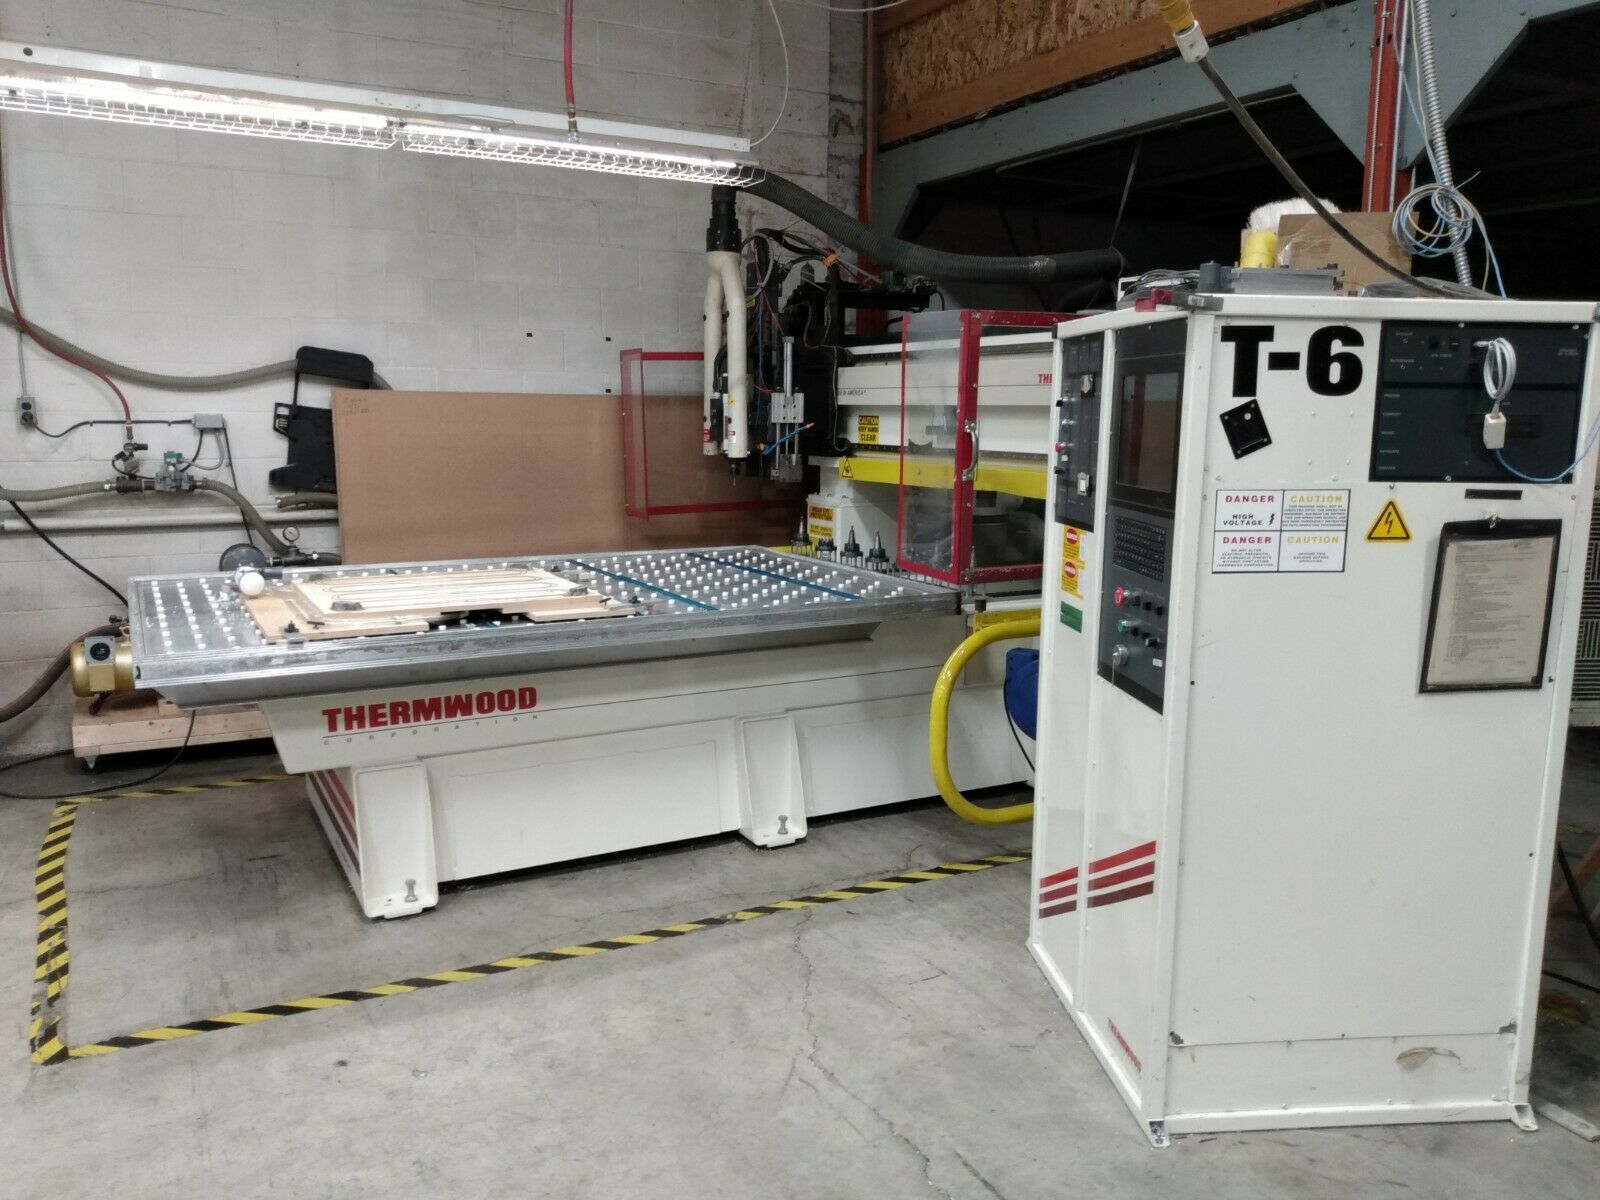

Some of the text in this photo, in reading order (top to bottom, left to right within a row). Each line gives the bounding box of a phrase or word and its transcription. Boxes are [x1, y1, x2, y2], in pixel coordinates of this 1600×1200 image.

[1221, 325, 1365, 398] T-6
[859, 416, 879, 425] CAUTION
[861, 434, 877, 442] CLEAR
[1225, 495, 1275, 503] DANGER
[1290, 495, 1343, 503] CAUTION
[1222, 536, 1272, 544] DANGER
[1287, 536, 1339, 544] CAUTION
[321, 686, 538, 733] THERMWOOD
[323, 713, 539, 746] CORPORATION
